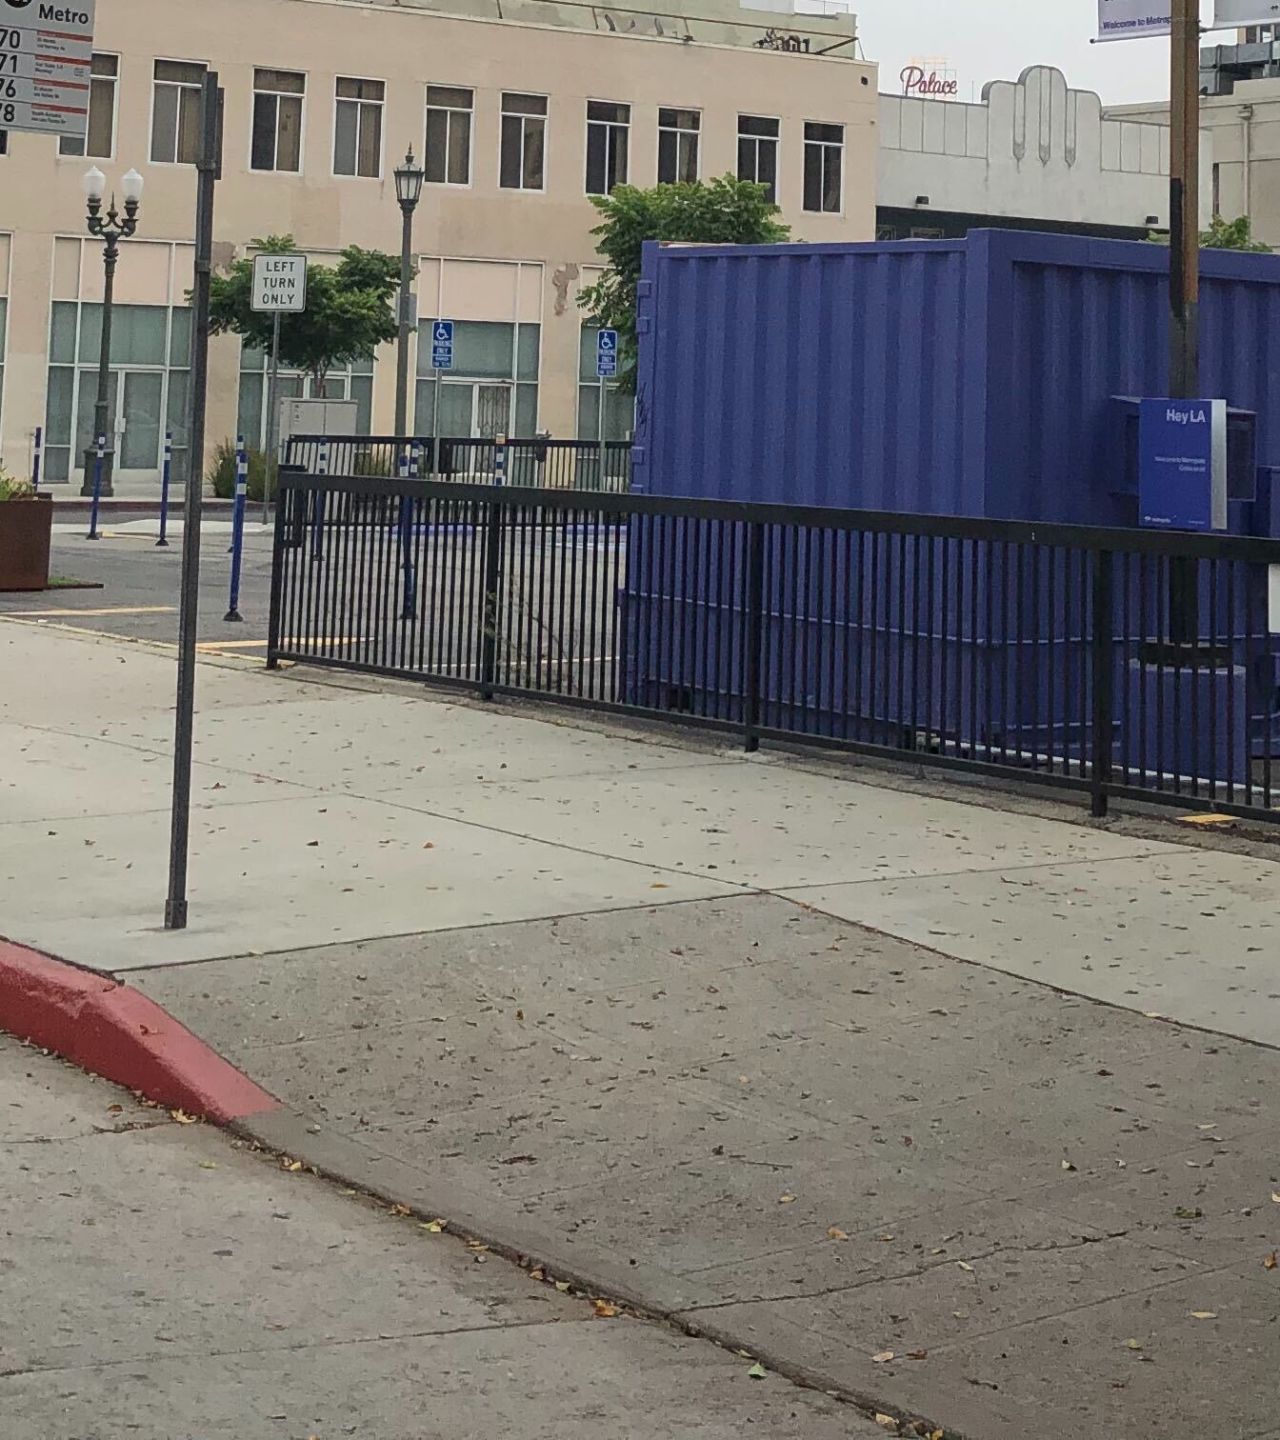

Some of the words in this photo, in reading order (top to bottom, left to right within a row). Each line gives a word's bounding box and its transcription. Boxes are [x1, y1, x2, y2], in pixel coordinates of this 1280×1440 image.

[39, 4, 88, 24] Metro
[900, 66, 958, 96] Palace
[266, 262, 295, 272] LEFT
[263, 277, 296, 288] TURN
[262, 293, 295, 304] ONLY
[1166, 408, 1188, 424] Hey
[1190, 410, 1206, 422] LA
